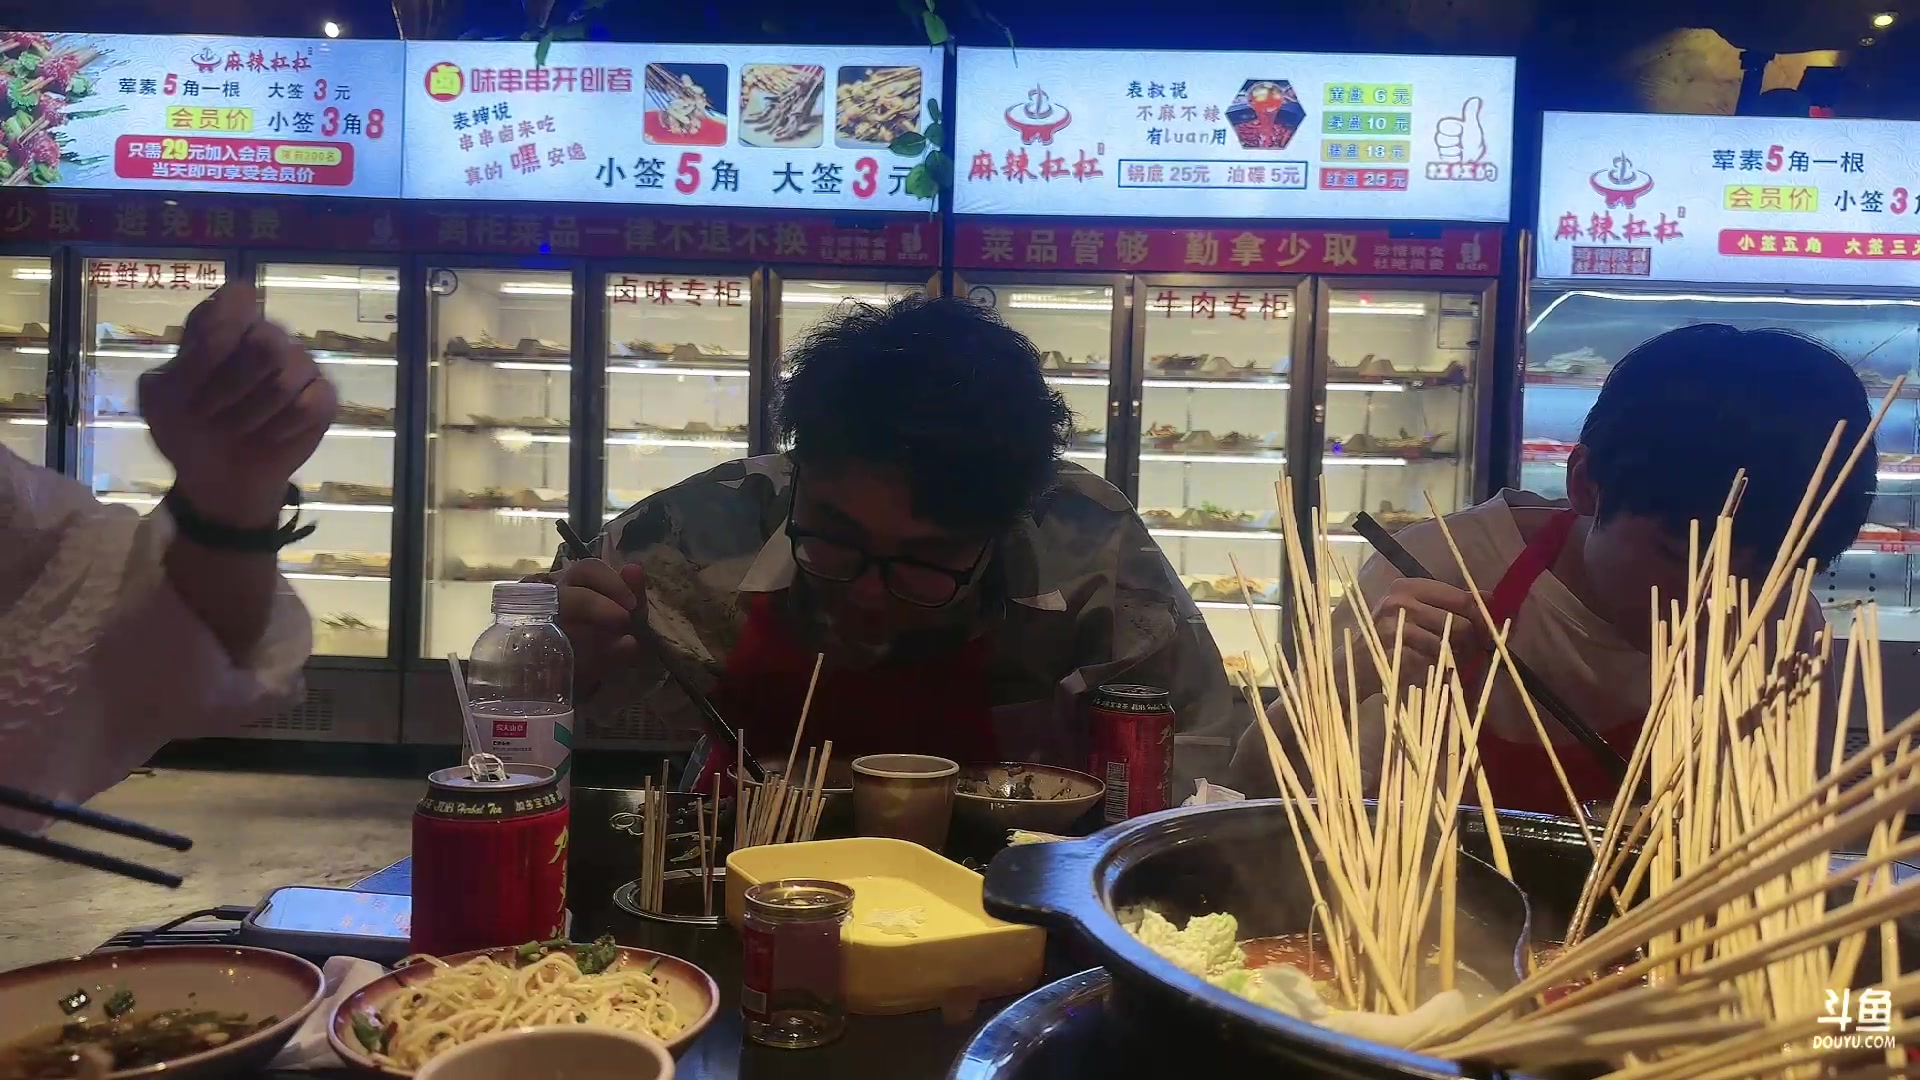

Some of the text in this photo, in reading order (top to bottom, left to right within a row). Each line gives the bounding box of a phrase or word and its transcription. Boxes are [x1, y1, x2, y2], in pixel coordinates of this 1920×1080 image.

[224, 49, 311, 72] 麻辣杠杠
[171, 107, 249, 131] 会员价
[1136, 104, 1221, 122] 不麻不辣
[459, 114, 556, 152] 串串卤来吃
[128, 138, 271, 162] 只需29元加入会员
[152, 161, 315, 183] 当天即可享受会员价
[968, 147, 1104, 184] 麻辣杠杠
[1729, 186, 1813, 212] 会员价
[1834, 187, 1920, 216] 小签3
[1554, 210, 1684, 244] 麻辣杠杠
[981, 228, 1358, 267] 菜品管够 勤拿少取
[1737, 233, 1823, 254] 小签五角
[90, 261, 219, 290] 海鲜及其他
[613, 276, 743, 307] 卤味专柜
[1156, 290, 1289, 320] 牛肉专柜
